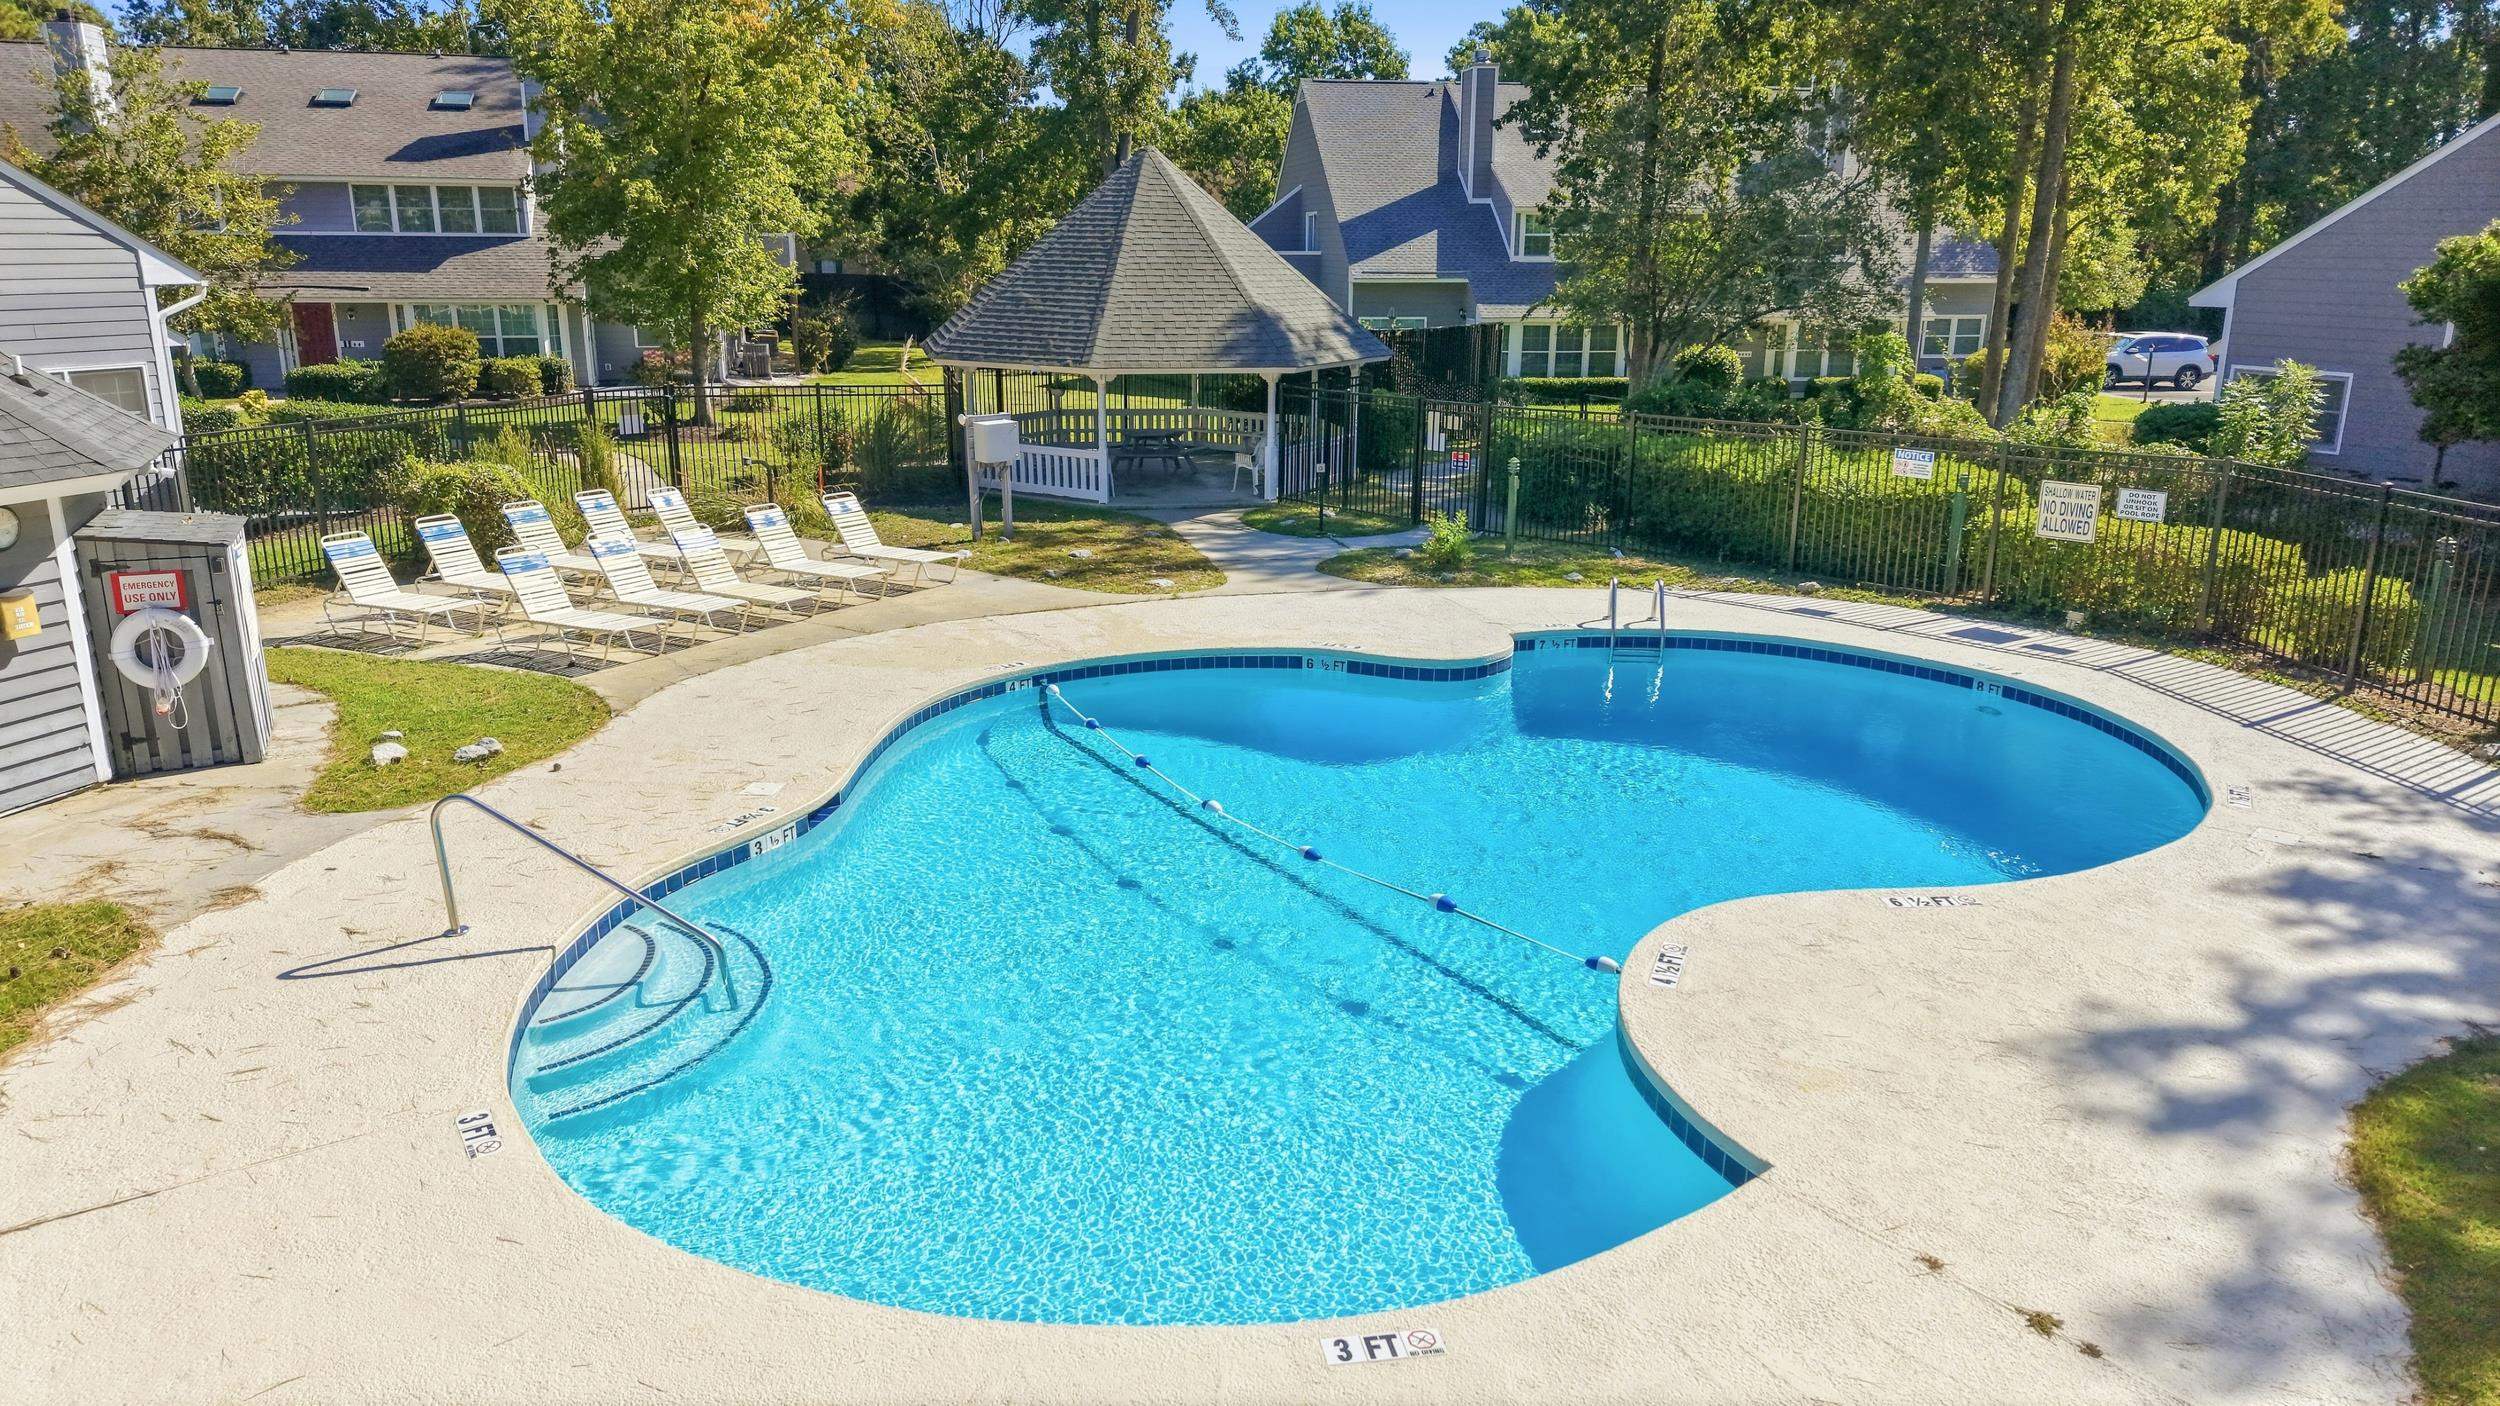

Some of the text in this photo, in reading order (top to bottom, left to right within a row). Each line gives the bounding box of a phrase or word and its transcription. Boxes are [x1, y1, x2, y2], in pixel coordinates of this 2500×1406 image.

[1897, 450, 1933, 462] NOTICE
[2044, 486, 2097, 501] SHALLOW WATER
[2042, 499, 2094, 519] NO DIVING
[2041, 516, 2090, 536] ALLOWED
[122, 580, 175, 590] EMERGENCY
[124, 591, 177, 604] USE ONLY
[1539, 640, 1546, 649] 7
[1563, 639, 1577, 648] FT
[1333, 660, 1347, 672] FT
[1009, 681, 1016, 691] 4
[1976, 681, 2001, 696] 8 FT
[754, 841, 763, 855] 3
[783, 826, 795, 843] FT
[1889, 897, 1903, 907] 6
[1930, 896, 1955, 906] FT
[1657, 952, 1683, 966] FT
[458, 1113, 497, 1142] 3 FT
[1333, 1333, 1399, 1362] 3 FT
